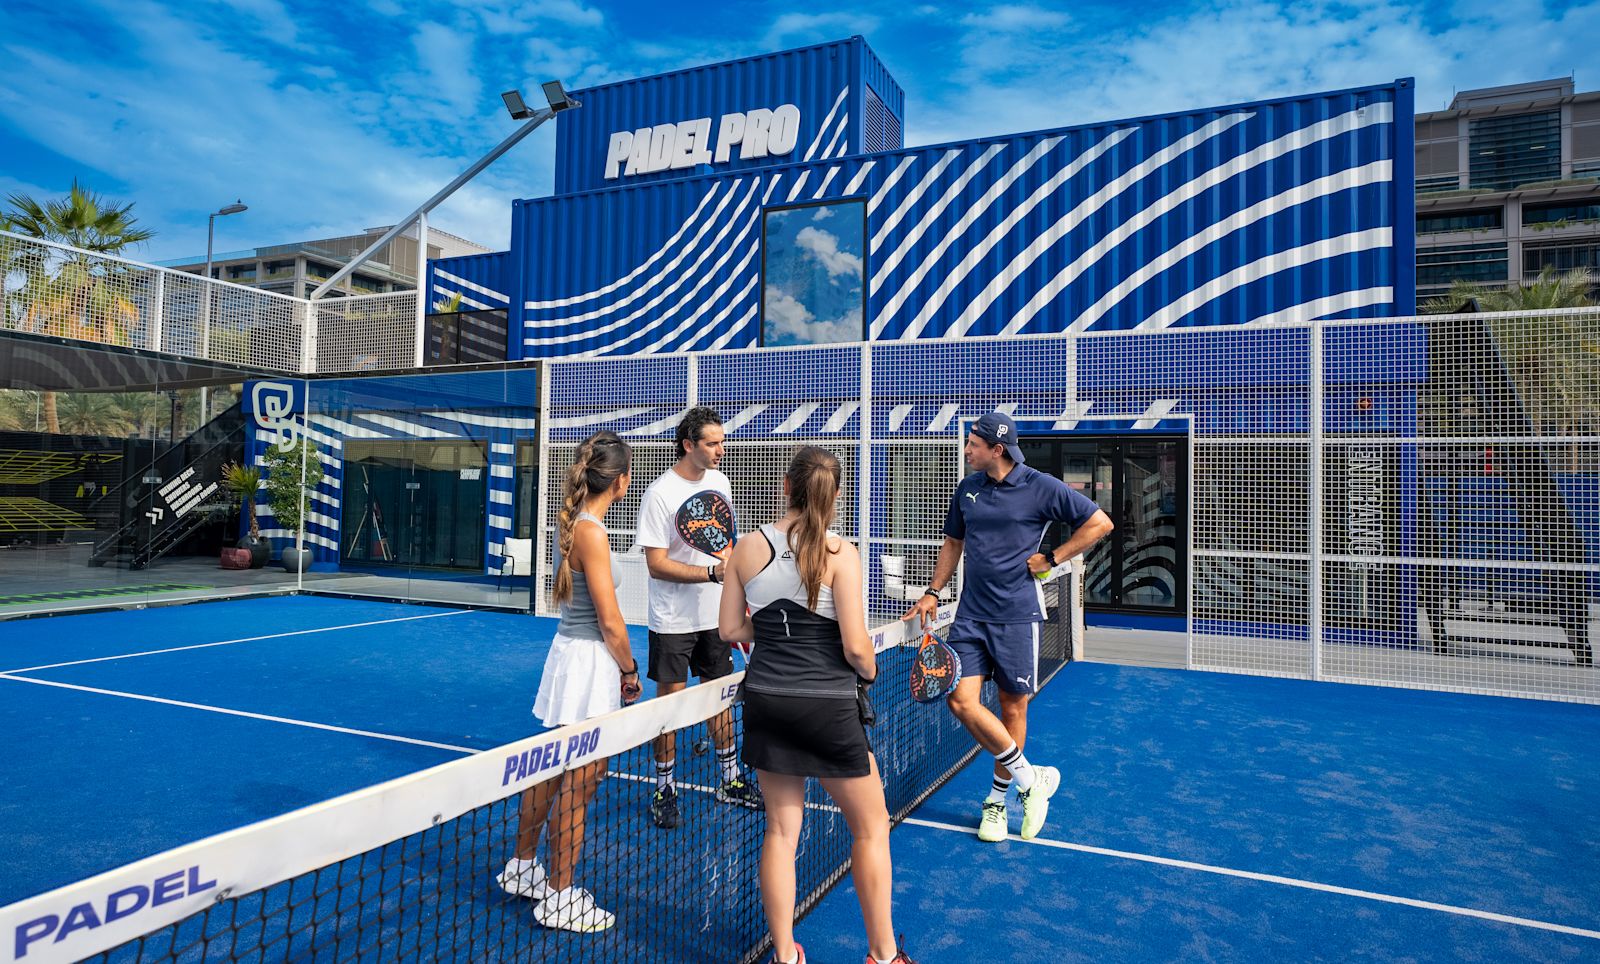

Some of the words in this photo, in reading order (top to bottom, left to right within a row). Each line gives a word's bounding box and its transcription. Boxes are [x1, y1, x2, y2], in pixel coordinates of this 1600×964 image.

[604, 117, 713, 180] PADEL
[714, 103, 801, 163] PRO
[158, 476, 183, 497] VIEWING
[180, 466, 196, 482] DECK
[164, 481, 191, 504] SHOWERS
[169, 482, 203, 511] WASHROOMS
[175, 494, 202, 518] CHANGING
[199, 481, 219, 500] ROOMS
[1348, 444, 1383, 571] ENTRANCE
[502, 739, 562, 787] PADEL
[564, 726, 601, 764] PRO
[14, 865, 218, 960] PADEL
